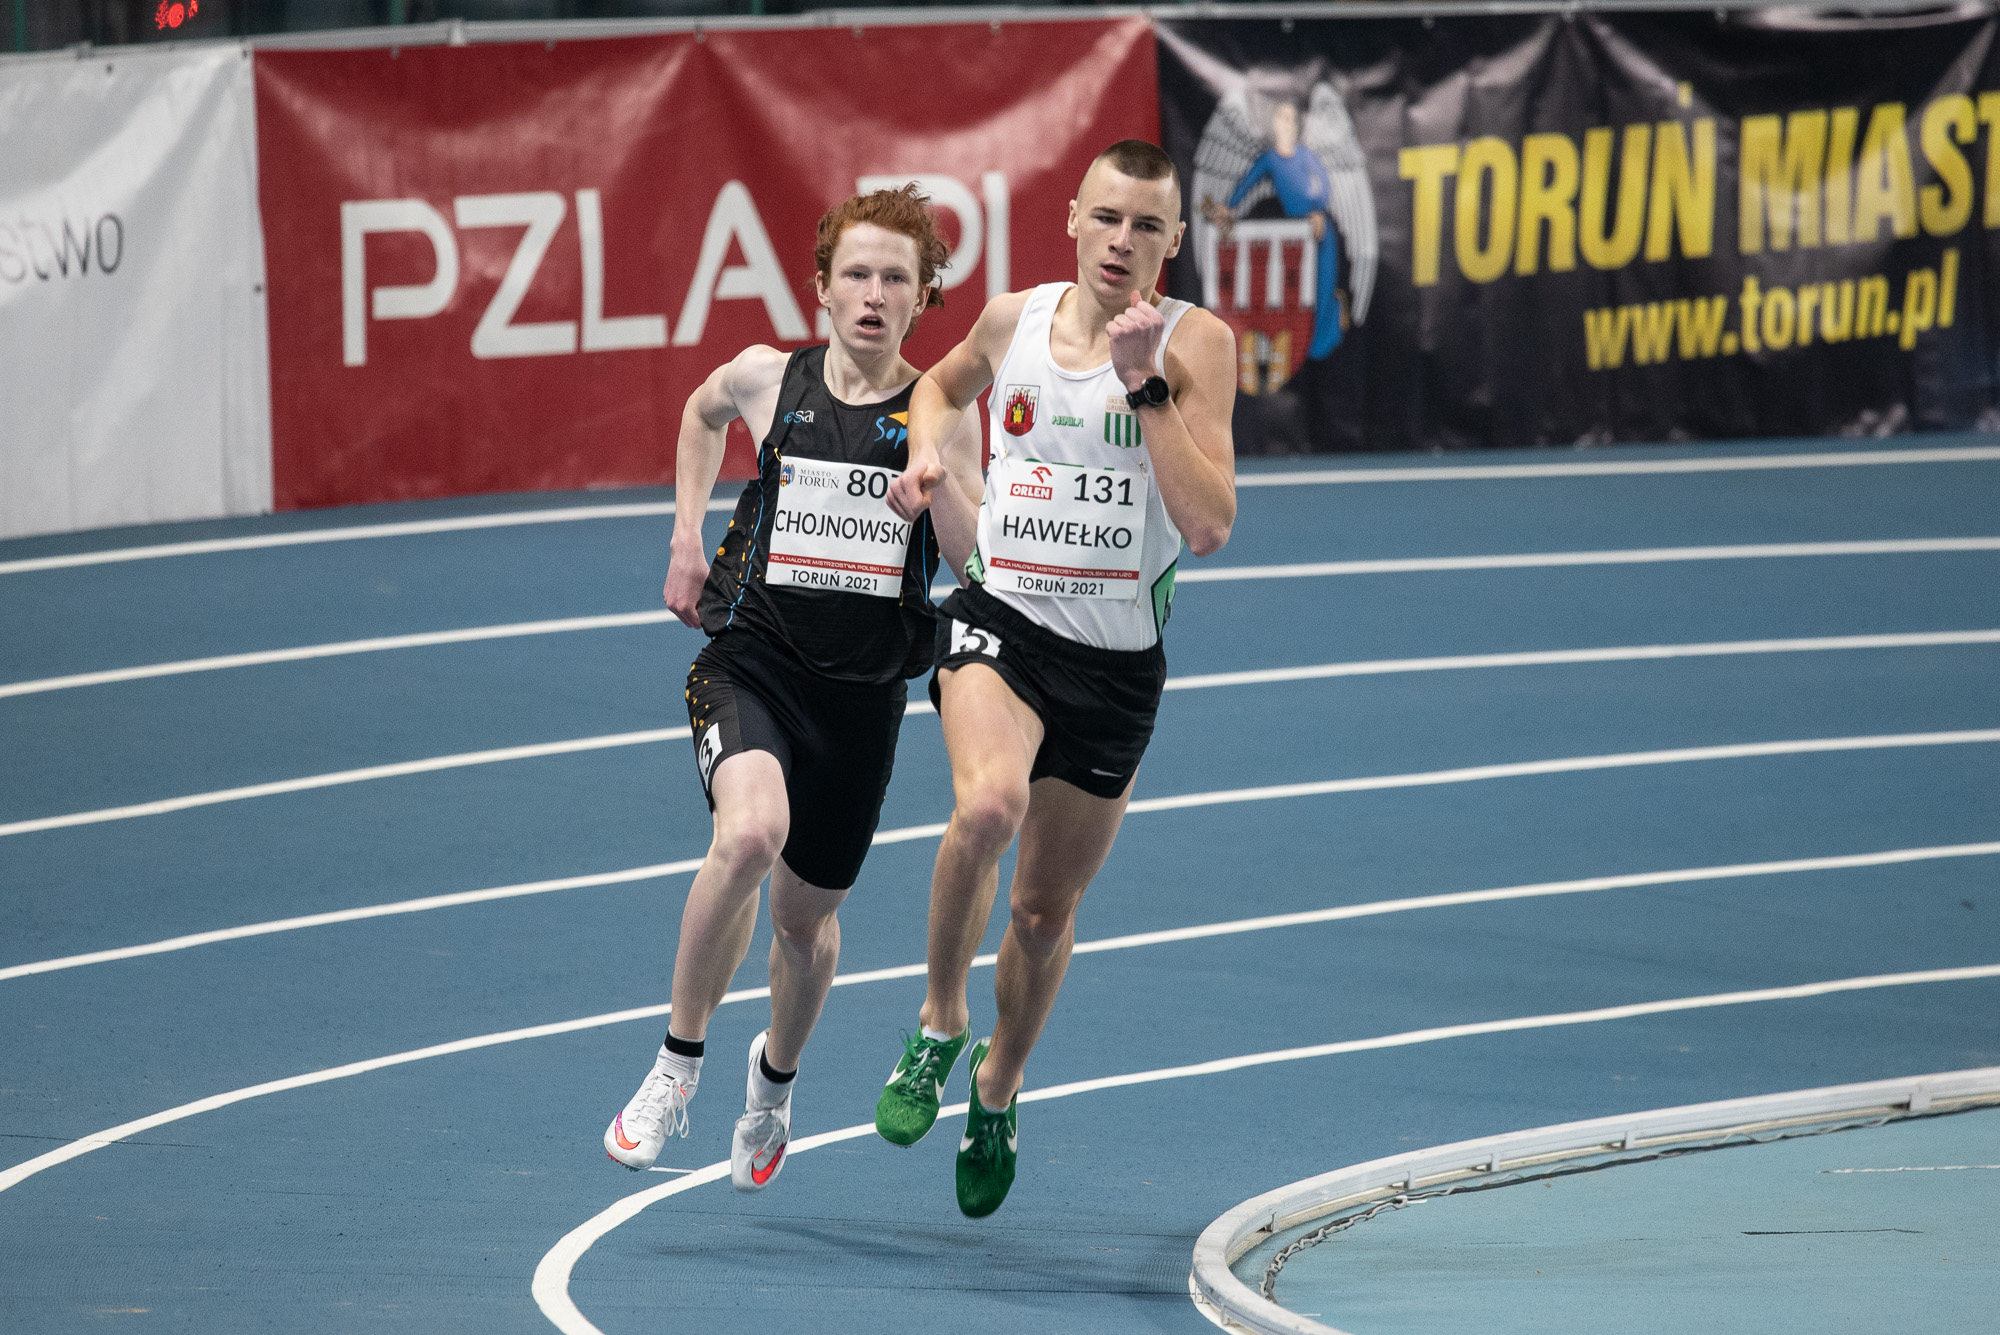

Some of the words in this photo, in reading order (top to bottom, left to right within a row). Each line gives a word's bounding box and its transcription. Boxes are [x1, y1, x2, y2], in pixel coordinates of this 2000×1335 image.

[1399, 82, 1717, 287] TORUŃ
[1583, 247, 1960, 371] www.torun.pl
[874, 416, 907, 449] Sop
[798, 475, 840, 489] TORUŃ
[800, 468, 831, 477] MIASTO
[846, 469, 901, 499] 80
[1011, 486, 1051, 498] ORLEN
[1074, 473, 1134, 507] 131
[774, 509, 911, 546] CHOJNOWSKI
[1002, 514, 1133, 549] HAWEŁKO
[785, 556, 811, 564] HALOWE
[811, 559, 857, 570] MISTRZOSTWA
[857, 564, 880, 572] POLSKI
[995, 559, 1012, 568] PZLA
[1011, 562, 1036, 571] HALOWE
[1035, 566, 1082, 576] MISTRZOSTWA
[791, 569, 840, 587] TORUŃ
[844, 575, 878, 591] 2021
[1017, 576, 1066, 594] TORUŃ
[1069, 581, 1104, 596] 2021
[960, 624, 988, 653] 5
[700, 737, 713, 776] 3
